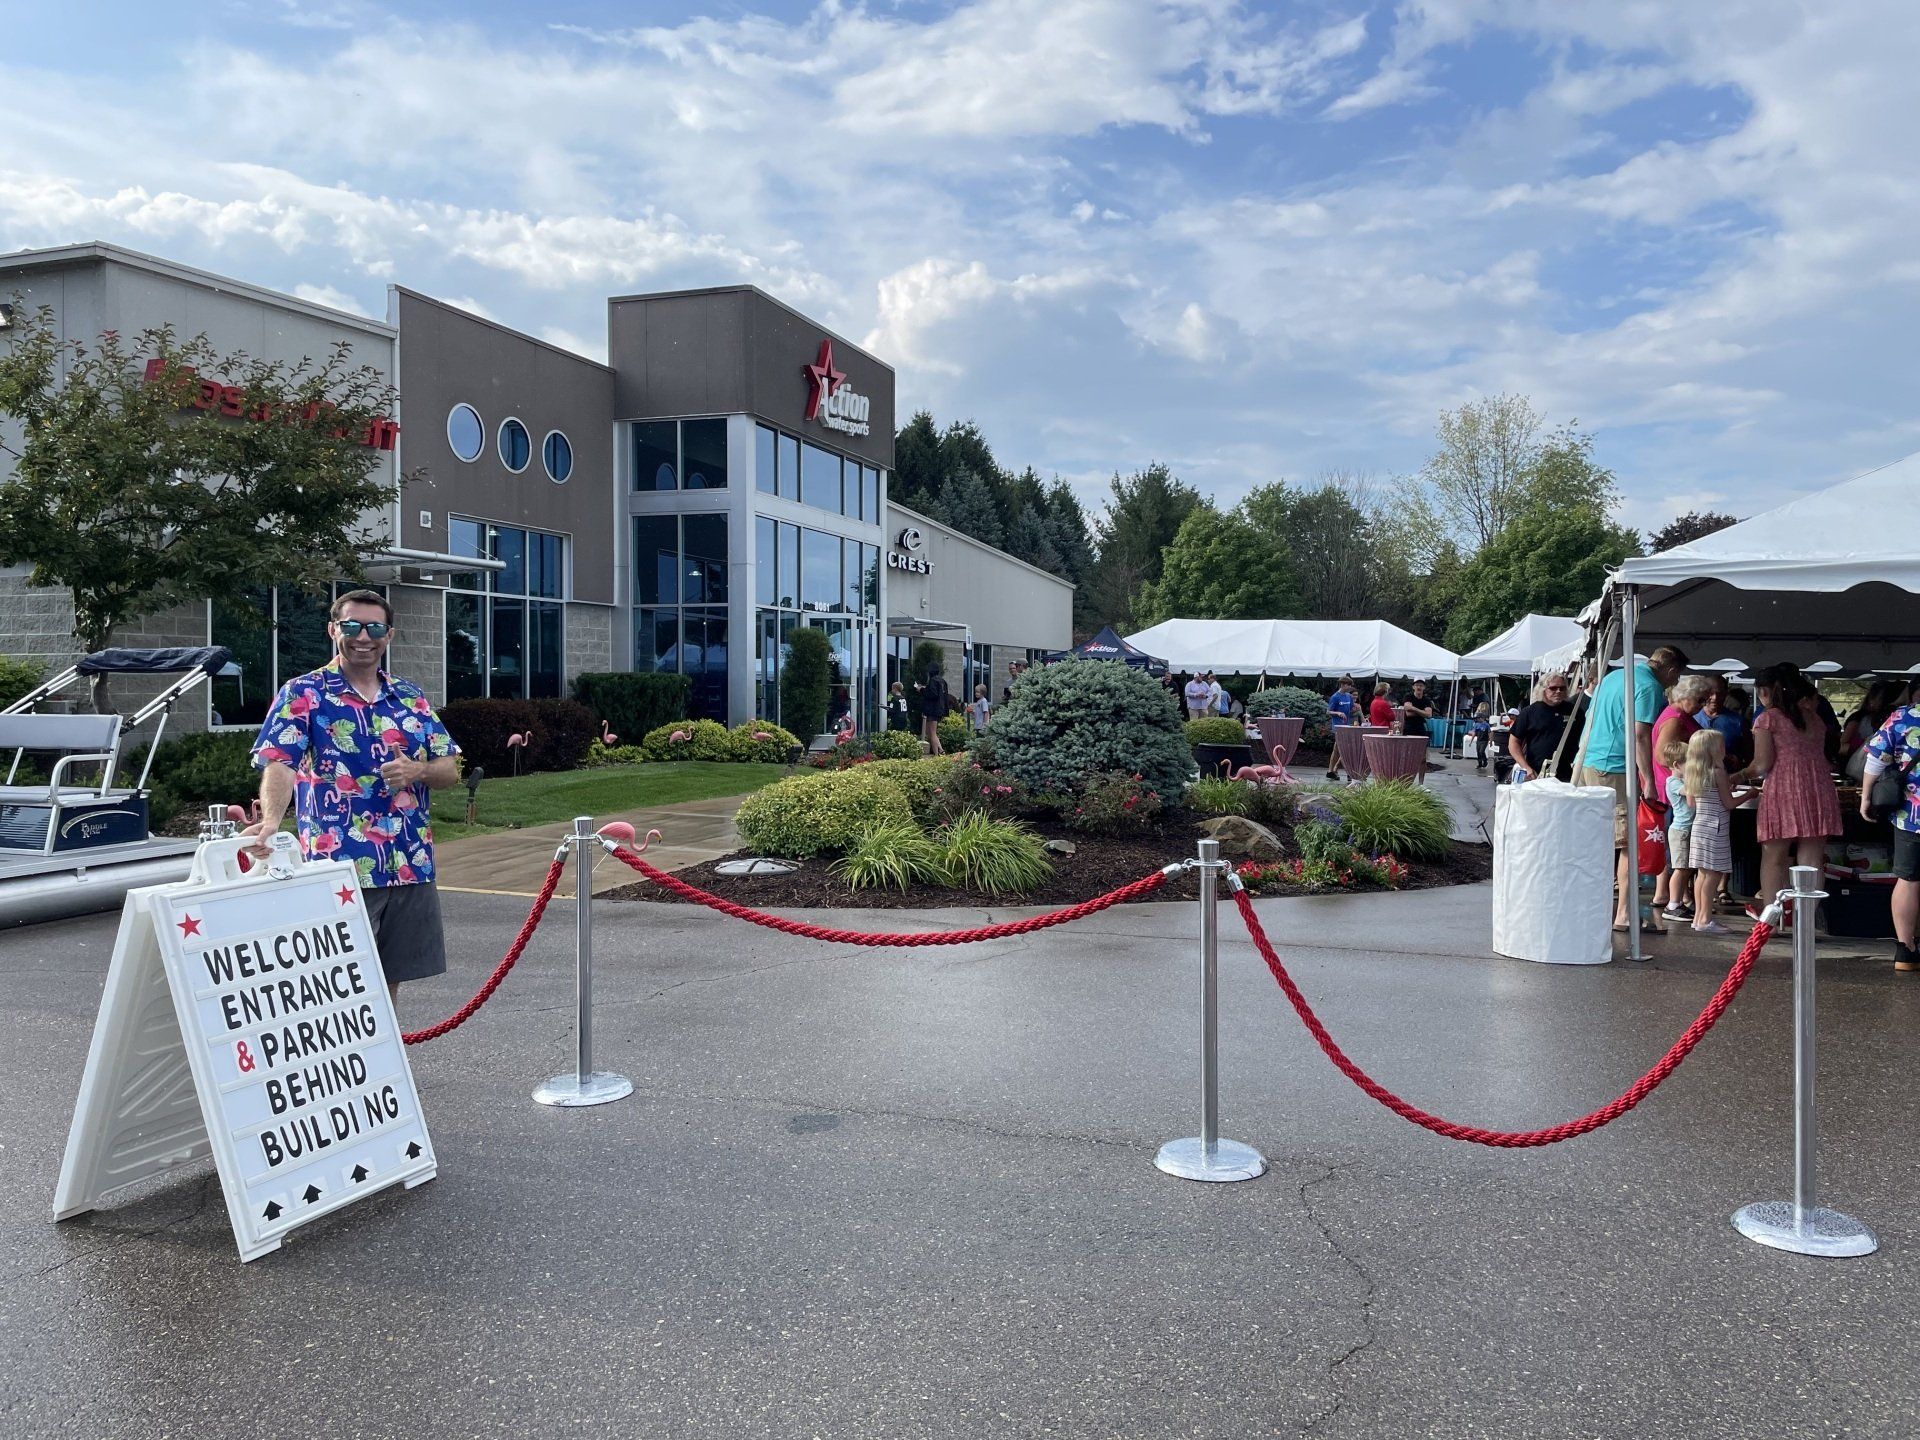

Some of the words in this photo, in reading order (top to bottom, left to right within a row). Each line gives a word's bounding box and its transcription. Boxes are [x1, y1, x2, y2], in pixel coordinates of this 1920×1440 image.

[819, 376, 870, 422] Action
[887, 551, 936, 575] CREST
[1086, 645, 1119, 653] Action
[203, 921, 355, 985] WELCOME
[222, 962, 366, 1030] ENTRANCE
[237, 1040, 256, 1072] &
[260, 1005, 376, 1068] PARKING
[266, 1053, 367, 1115] BEHIND
[260, 1085, 399, 1168] BUILDING
